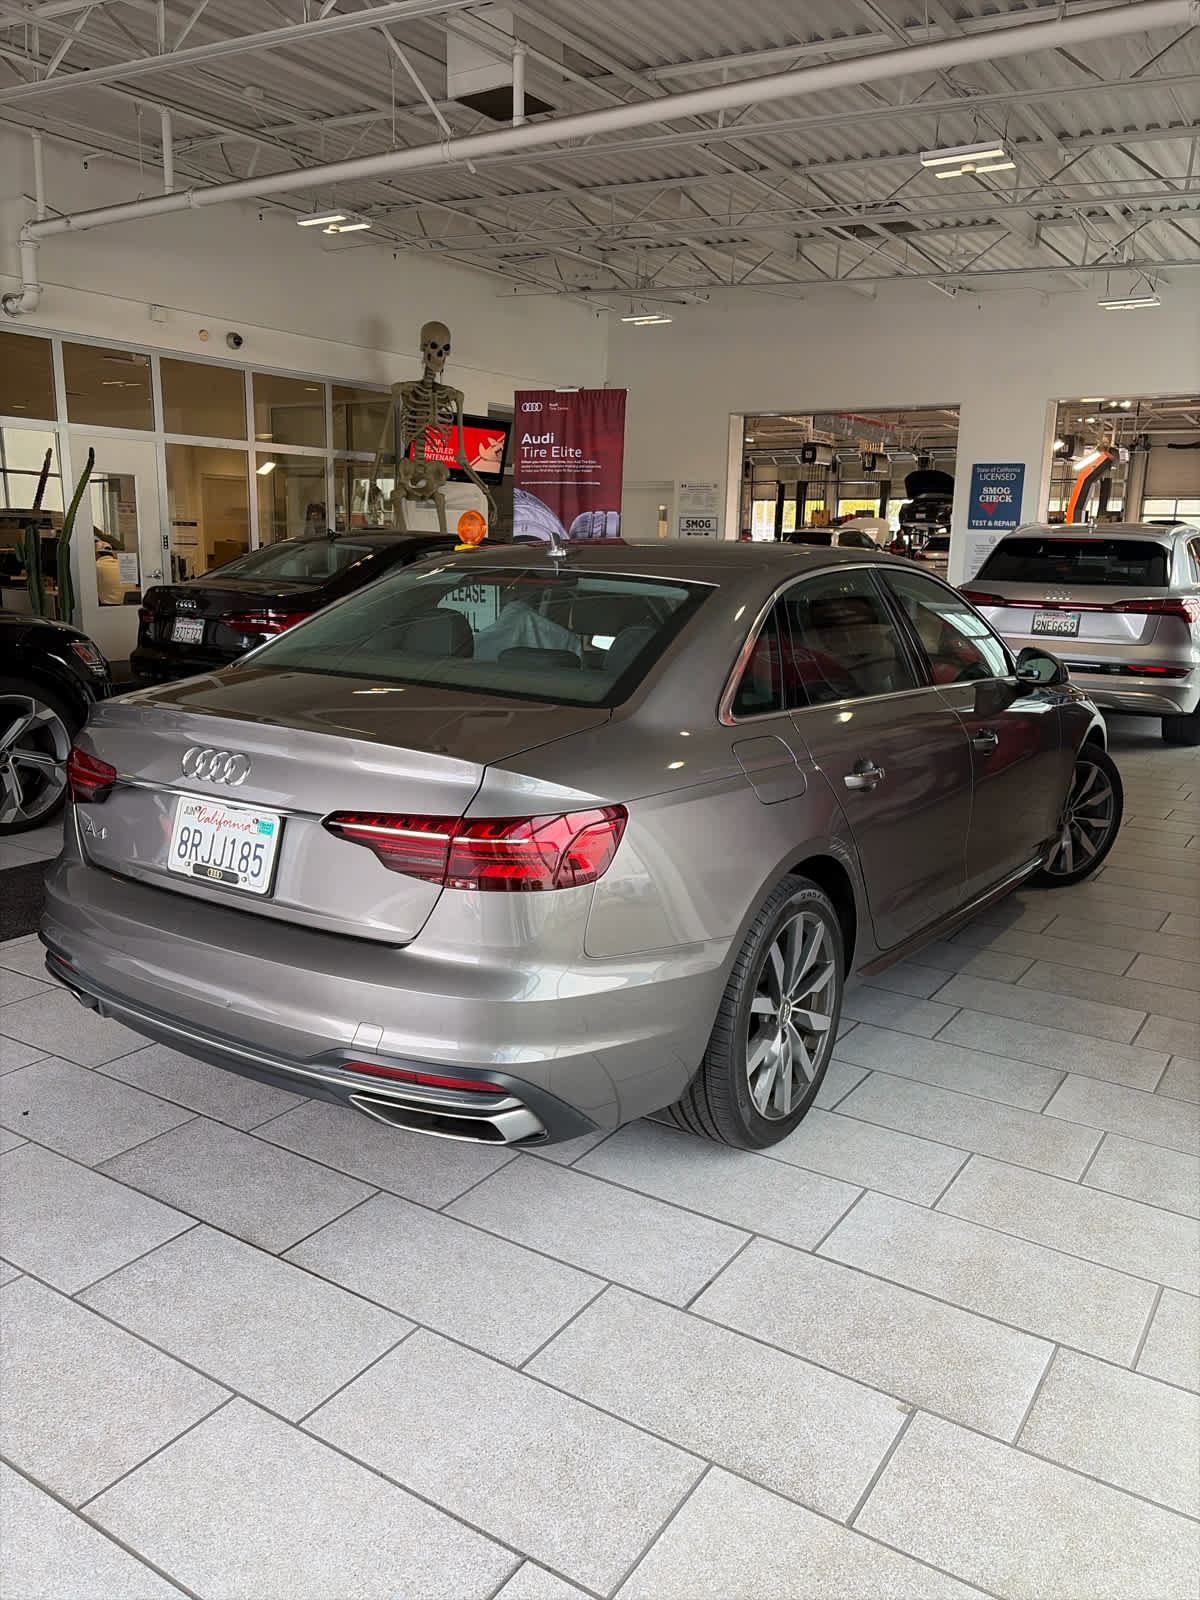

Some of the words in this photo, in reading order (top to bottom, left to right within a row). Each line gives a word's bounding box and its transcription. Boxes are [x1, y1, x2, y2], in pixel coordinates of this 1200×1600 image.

[521, 432, 554, 444] Audi
[521, 446, 547, 458] Tire
[551, 446, 582, 458] Elite
[979, 473, 1017, 481] LICENSED
[982, 486, 1011, 495] SMOG
[979, 494, 1013, 503] CHECK
[686, 519, 711, 528] SMOG
[972, 519, 987, 527] TEST
[993, 520, 1017, 528] REPAIR
[1034, 619, 1076, 633] 9NEG659
[197, 807, 257, 834] California
[177, 826, 264, 878] 8RJJ185
